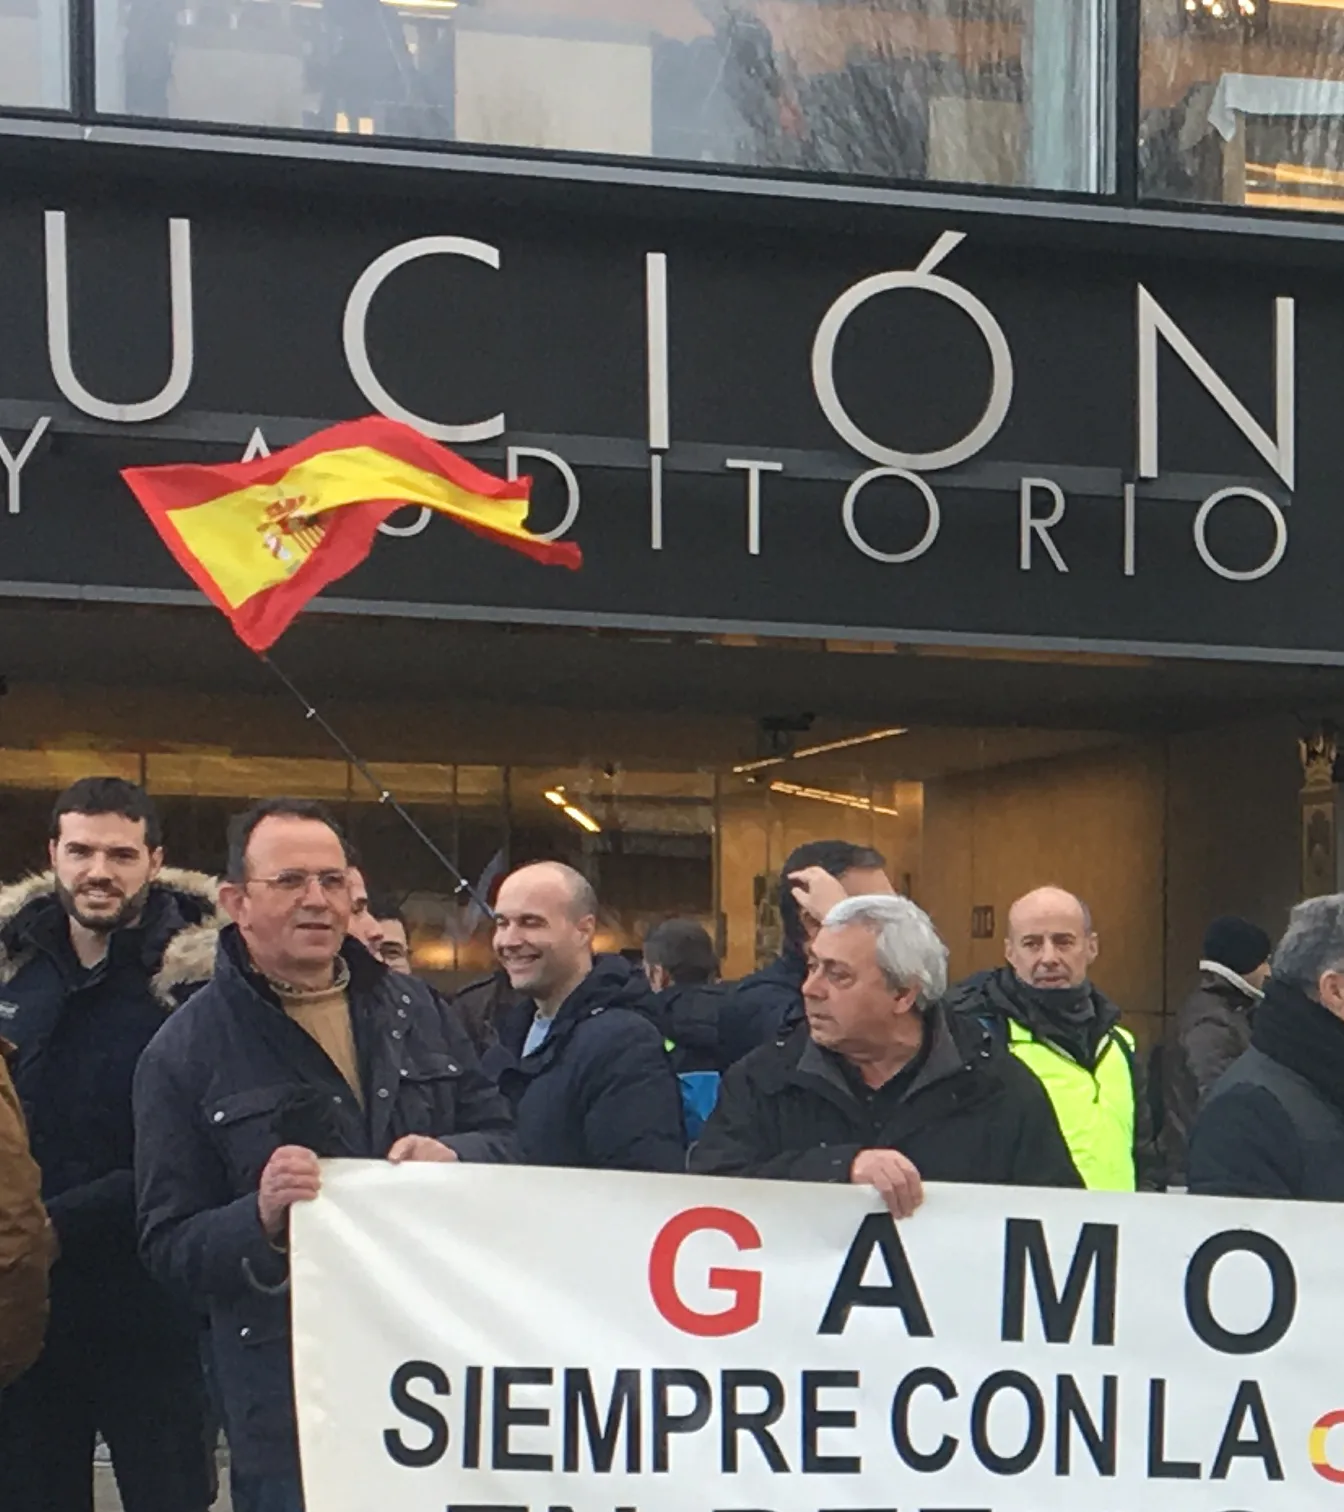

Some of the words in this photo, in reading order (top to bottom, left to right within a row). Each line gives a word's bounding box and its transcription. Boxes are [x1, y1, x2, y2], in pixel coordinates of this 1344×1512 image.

[240, 427, 1288, 581] DITORIO
[384, 1361, 861, 1474] SIEMPRE
[891, 1367, 1117, 1476] CON
[1148, 1379, 1284, 1481] LA
